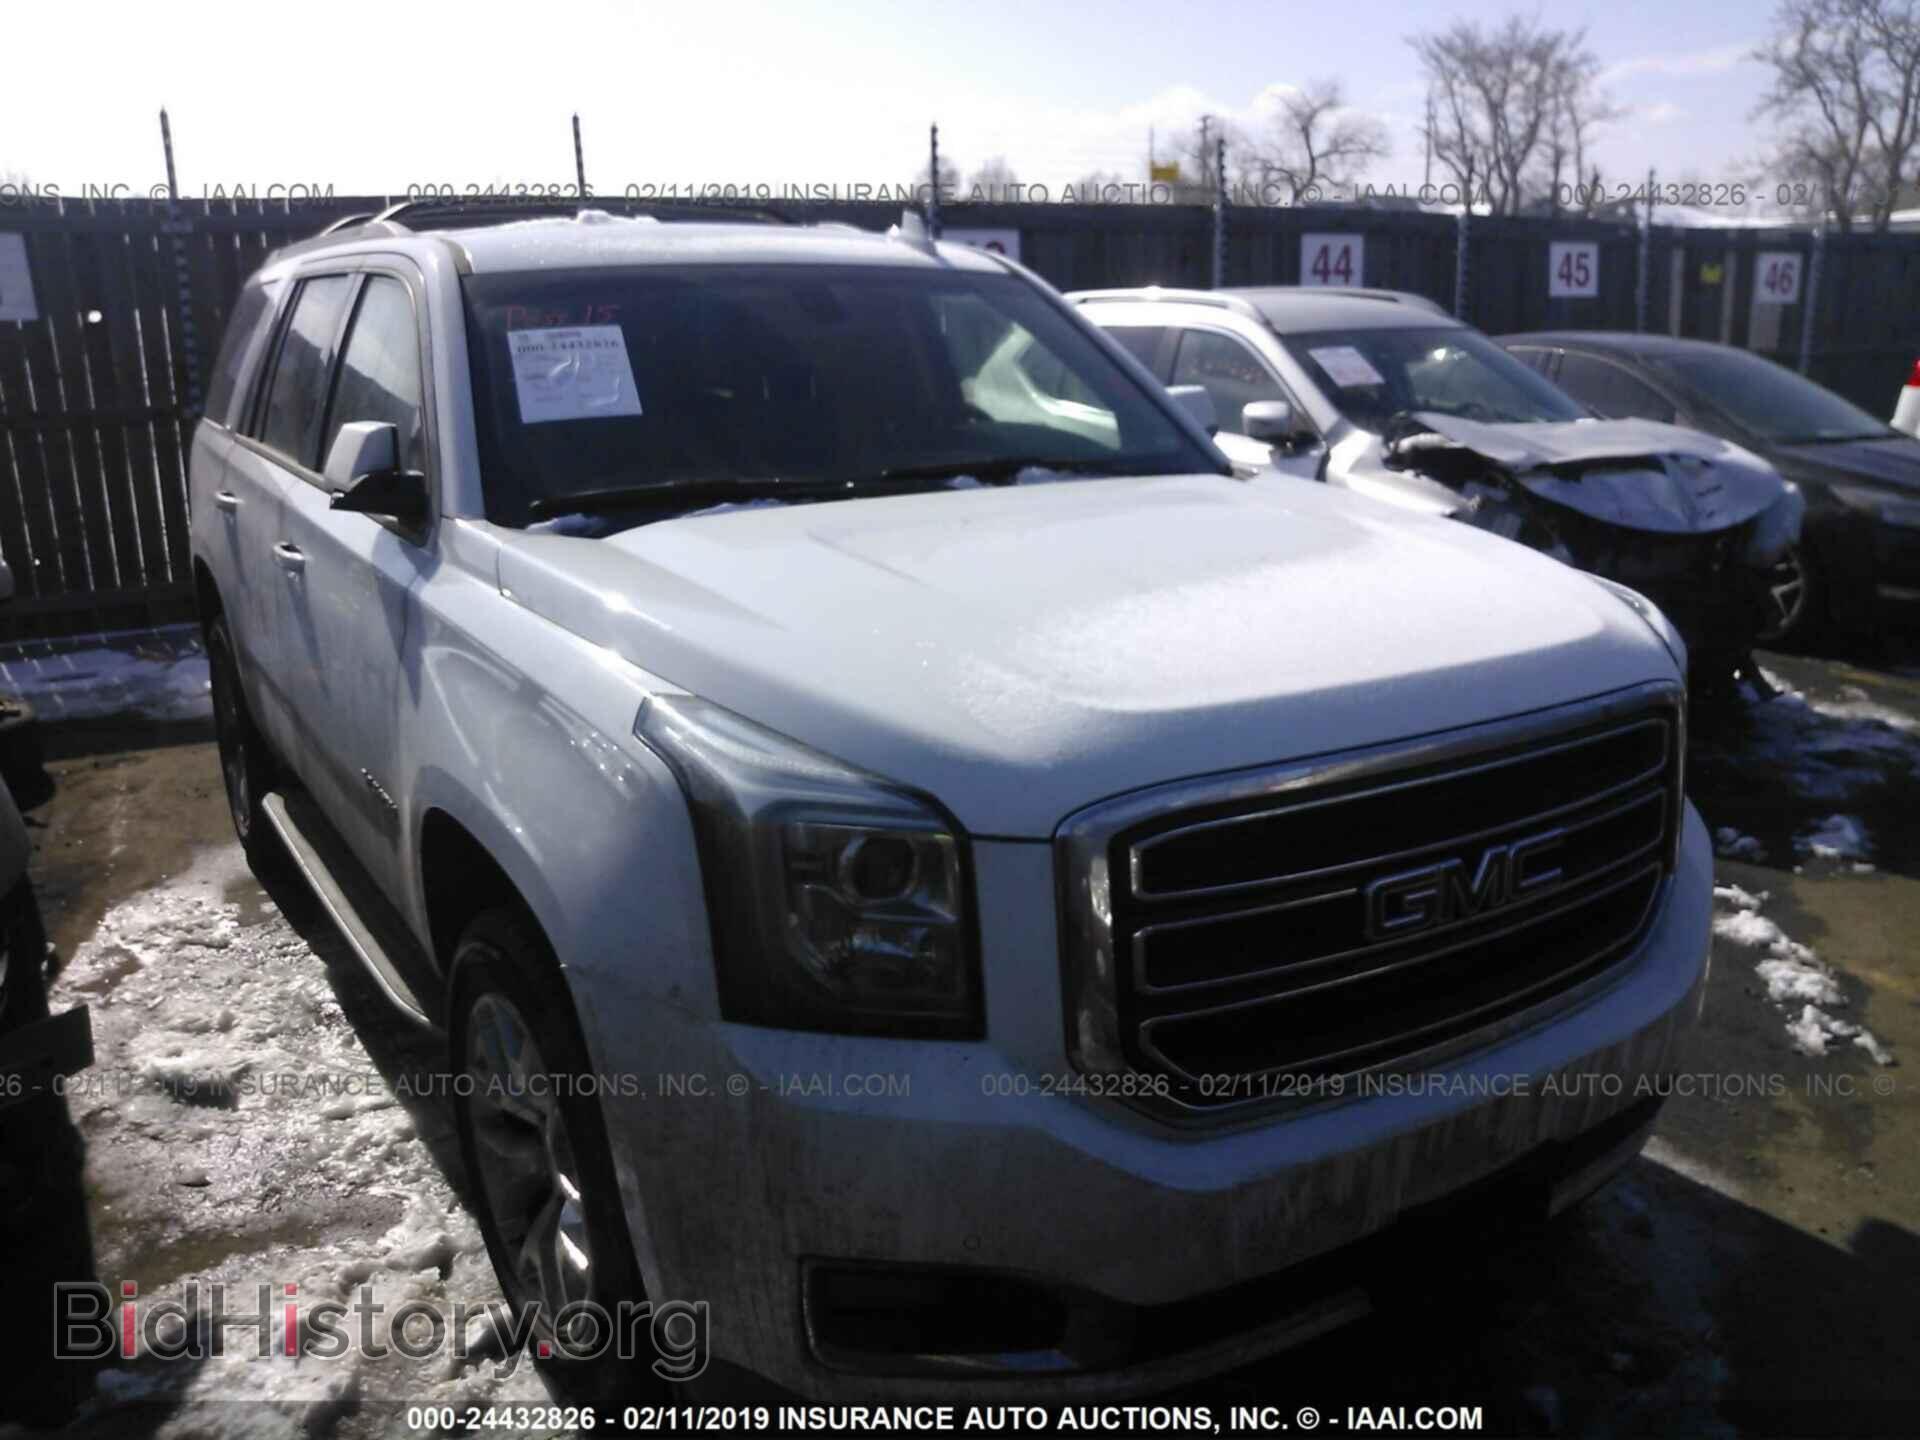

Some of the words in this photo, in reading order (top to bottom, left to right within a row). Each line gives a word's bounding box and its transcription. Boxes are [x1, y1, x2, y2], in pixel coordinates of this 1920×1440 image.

[1311, 244, 1353, 286] 44
[1557, 251, 1590, 288] 45
[1764, 261, 1794, 294] 46
[1363, 829, 1570, 939] GMC
